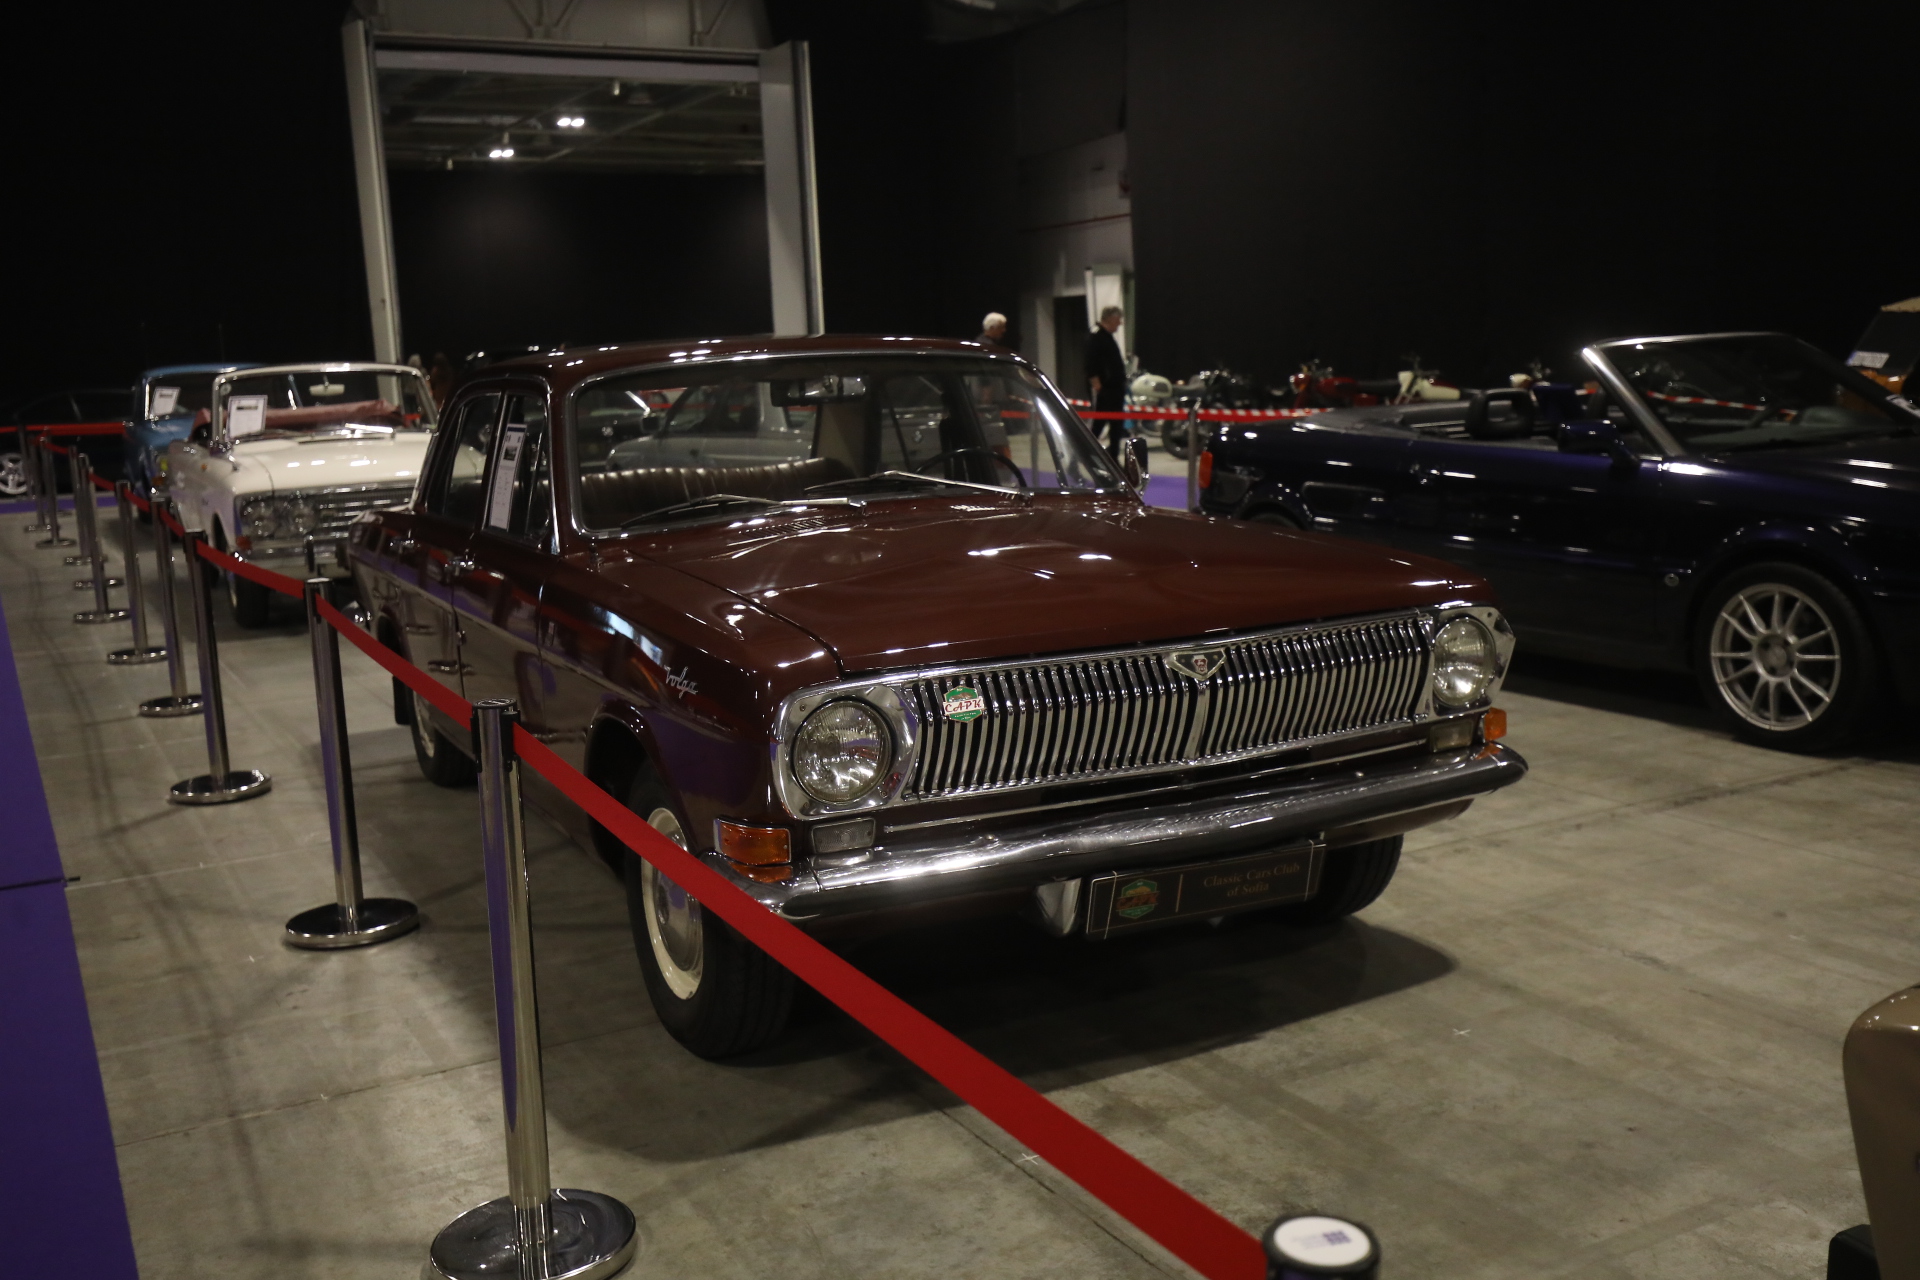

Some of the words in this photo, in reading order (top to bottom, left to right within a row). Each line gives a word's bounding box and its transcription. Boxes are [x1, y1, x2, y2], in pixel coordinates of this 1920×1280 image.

[663, 664, 699, 699] Volga
[1203, 872, 1242, 888] Classic
[1246, 869, 1271, 880] Cars
[1273, 862, 1300, 876] Club
[1227, 885, 1240, 897] of
[1242, 881, 1270, 895] Sofia
